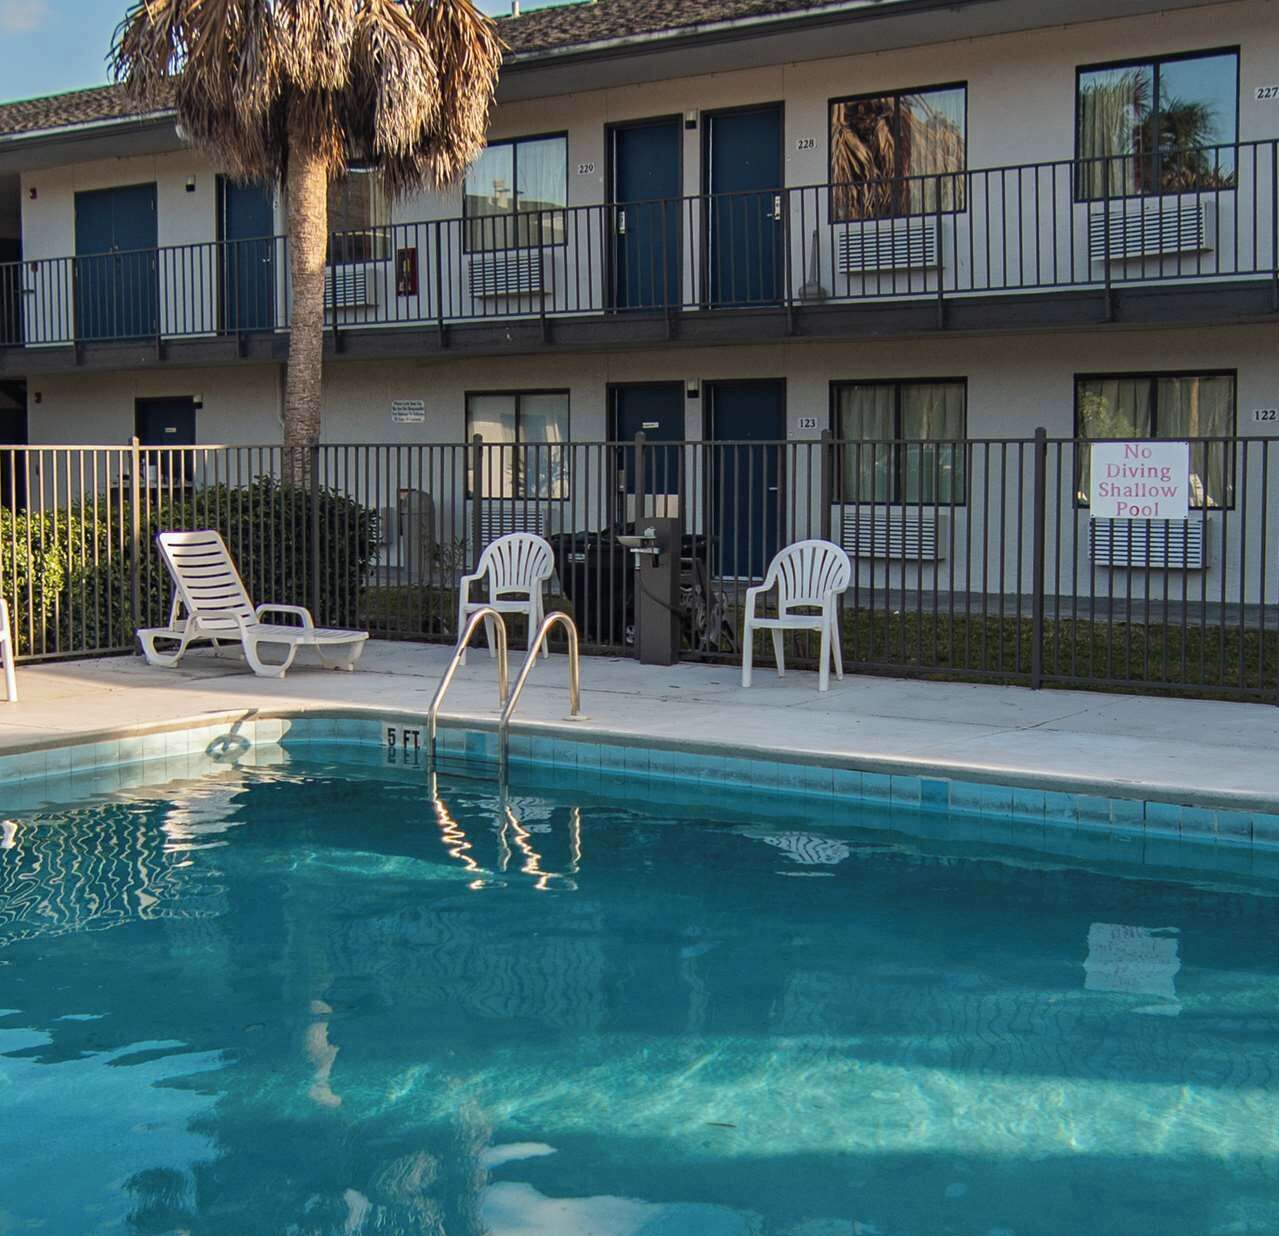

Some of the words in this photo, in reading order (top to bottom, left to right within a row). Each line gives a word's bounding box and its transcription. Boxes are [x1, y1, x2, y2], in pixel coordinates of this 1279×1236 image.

[1257, 86, 1279, 98] 227
[798, 139, 815, 149] 228
[1256, 410, 1276, 420] 122
[800, 418, 816, 428] 123
[1124, 444, 1152, 459] No
[1106, 463, 1171, 482] Diving
[1099, 482, 1178, 497] Shallow
[1116, 501, 1159, 517] Pool
[388, 728, 396, 746] 5
